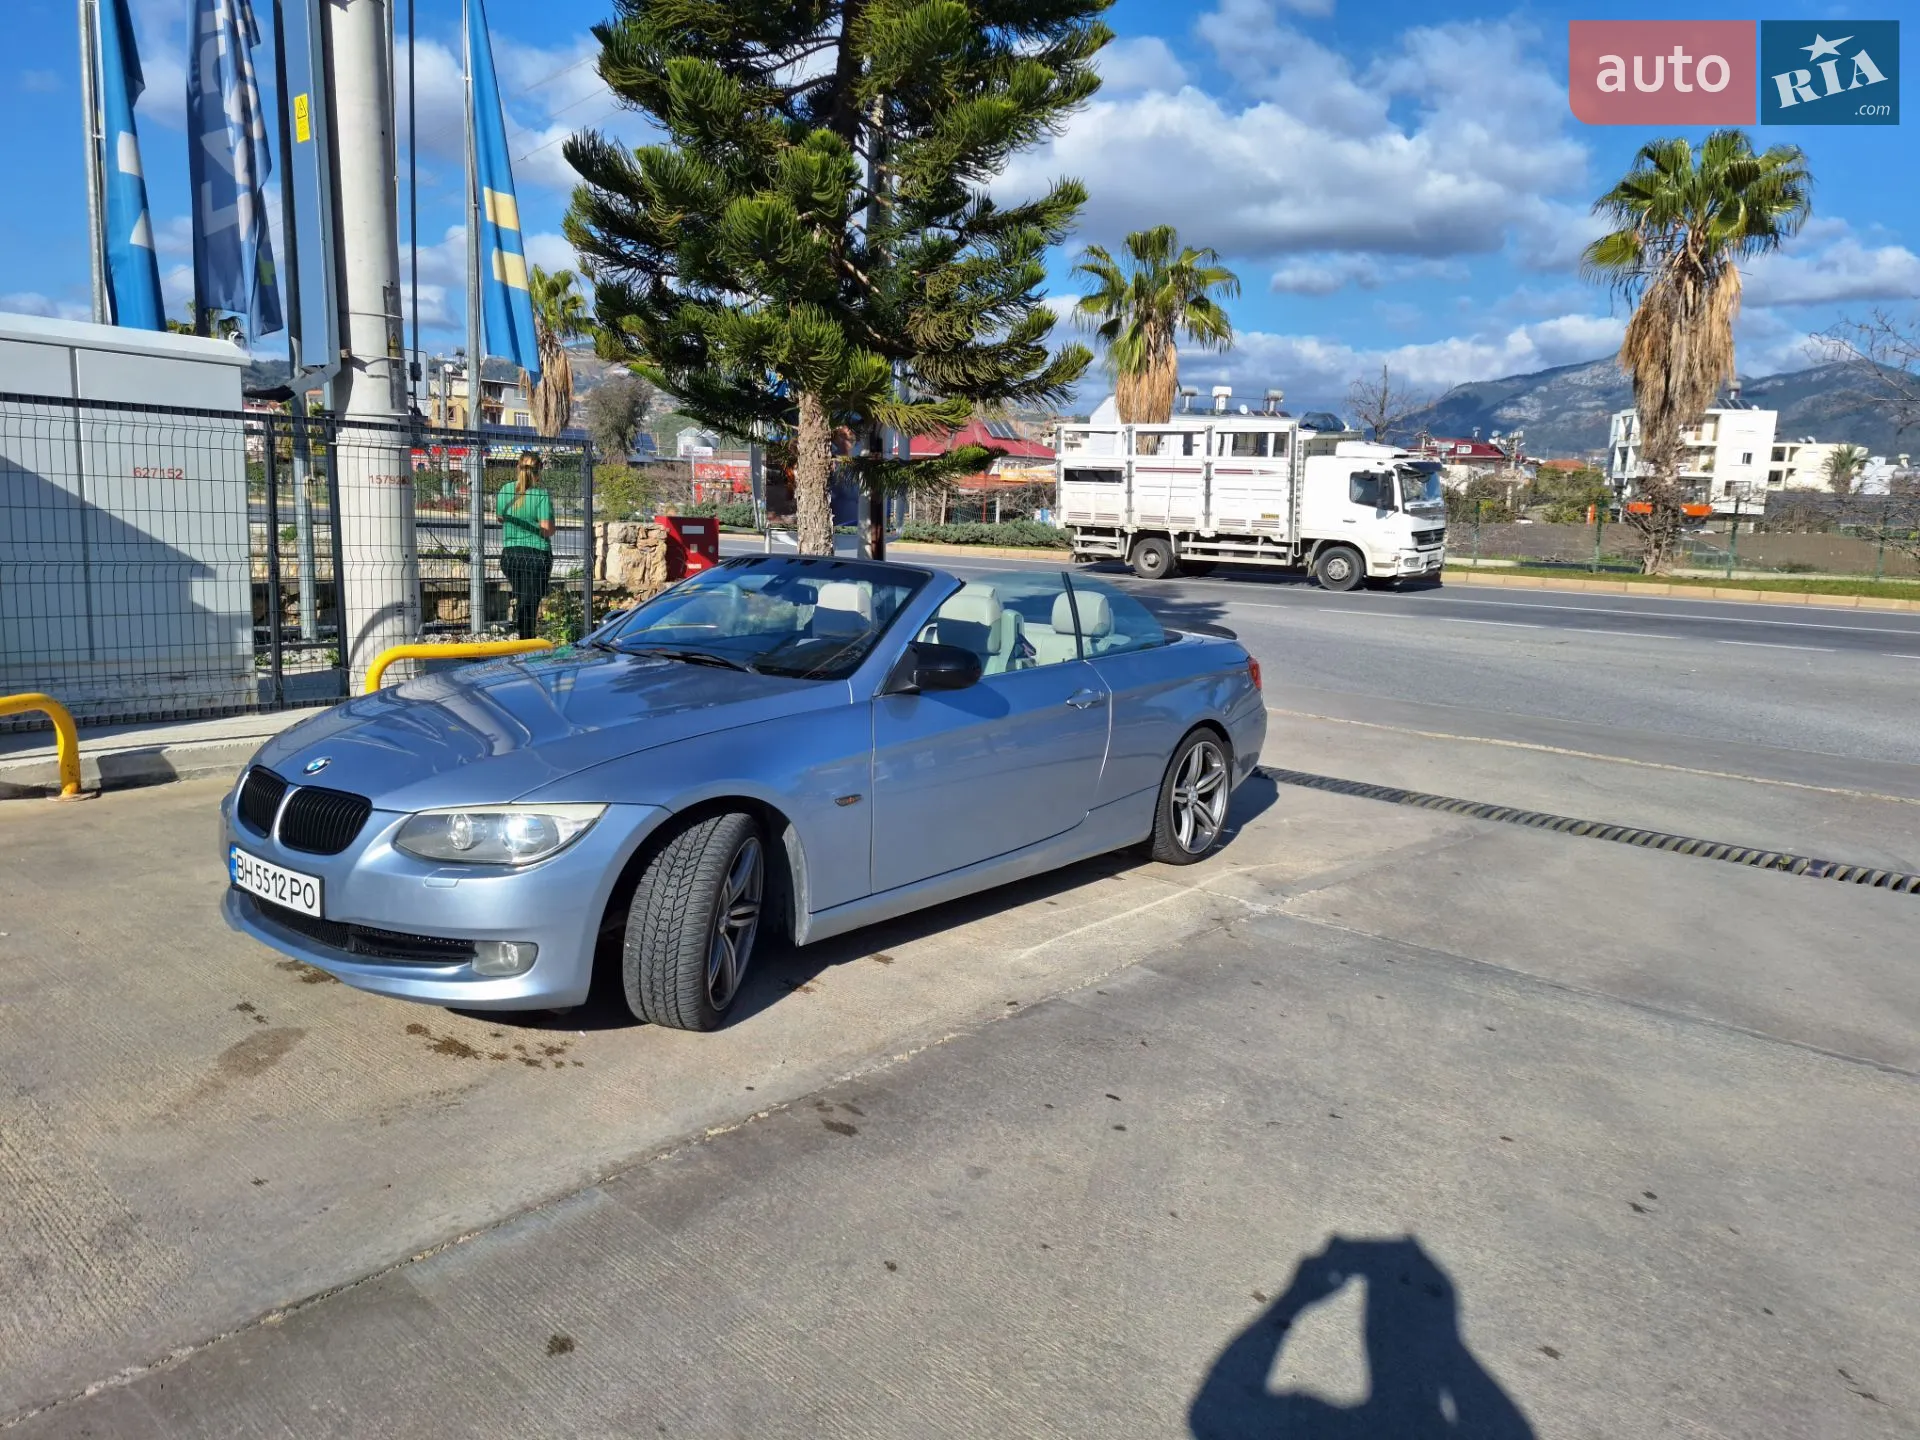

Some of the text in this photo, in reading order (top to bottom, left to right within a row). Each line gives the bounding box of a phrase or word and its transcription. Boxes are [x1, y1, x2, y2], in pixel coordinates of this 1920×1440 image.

[133, 466, 184, 480] 627152
[236, 855, 315, 909] BH 5512 PO
